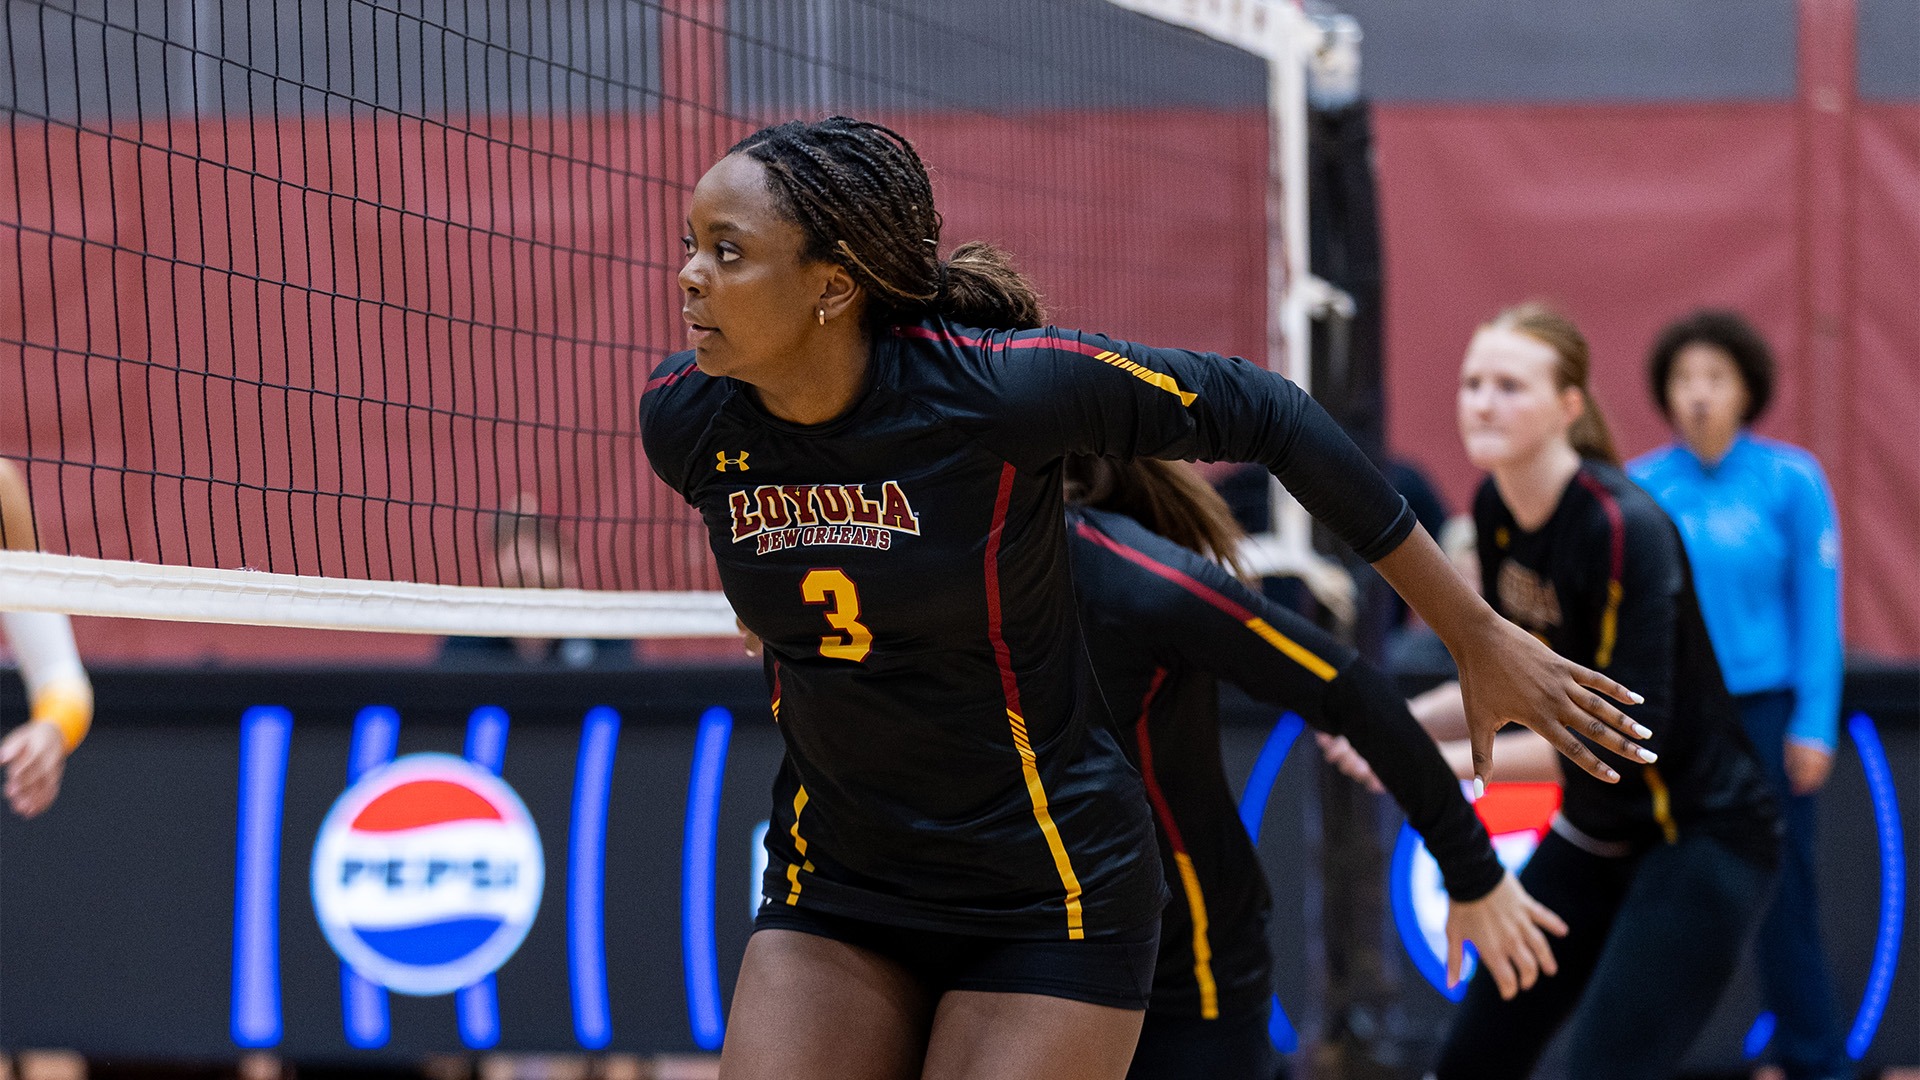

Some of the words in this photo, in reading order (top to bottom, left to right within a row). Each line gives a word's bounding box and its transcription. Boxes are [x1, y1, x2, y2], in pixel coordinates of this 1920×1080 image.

[729, 481, 920, 543] LOYOLA
[757, 528, 801, 555] NEW
[802, 526, 891, 550] ORLEANS
[800, 567, 873, 663] 3
[340, 859, 519, 889] PEPSI
